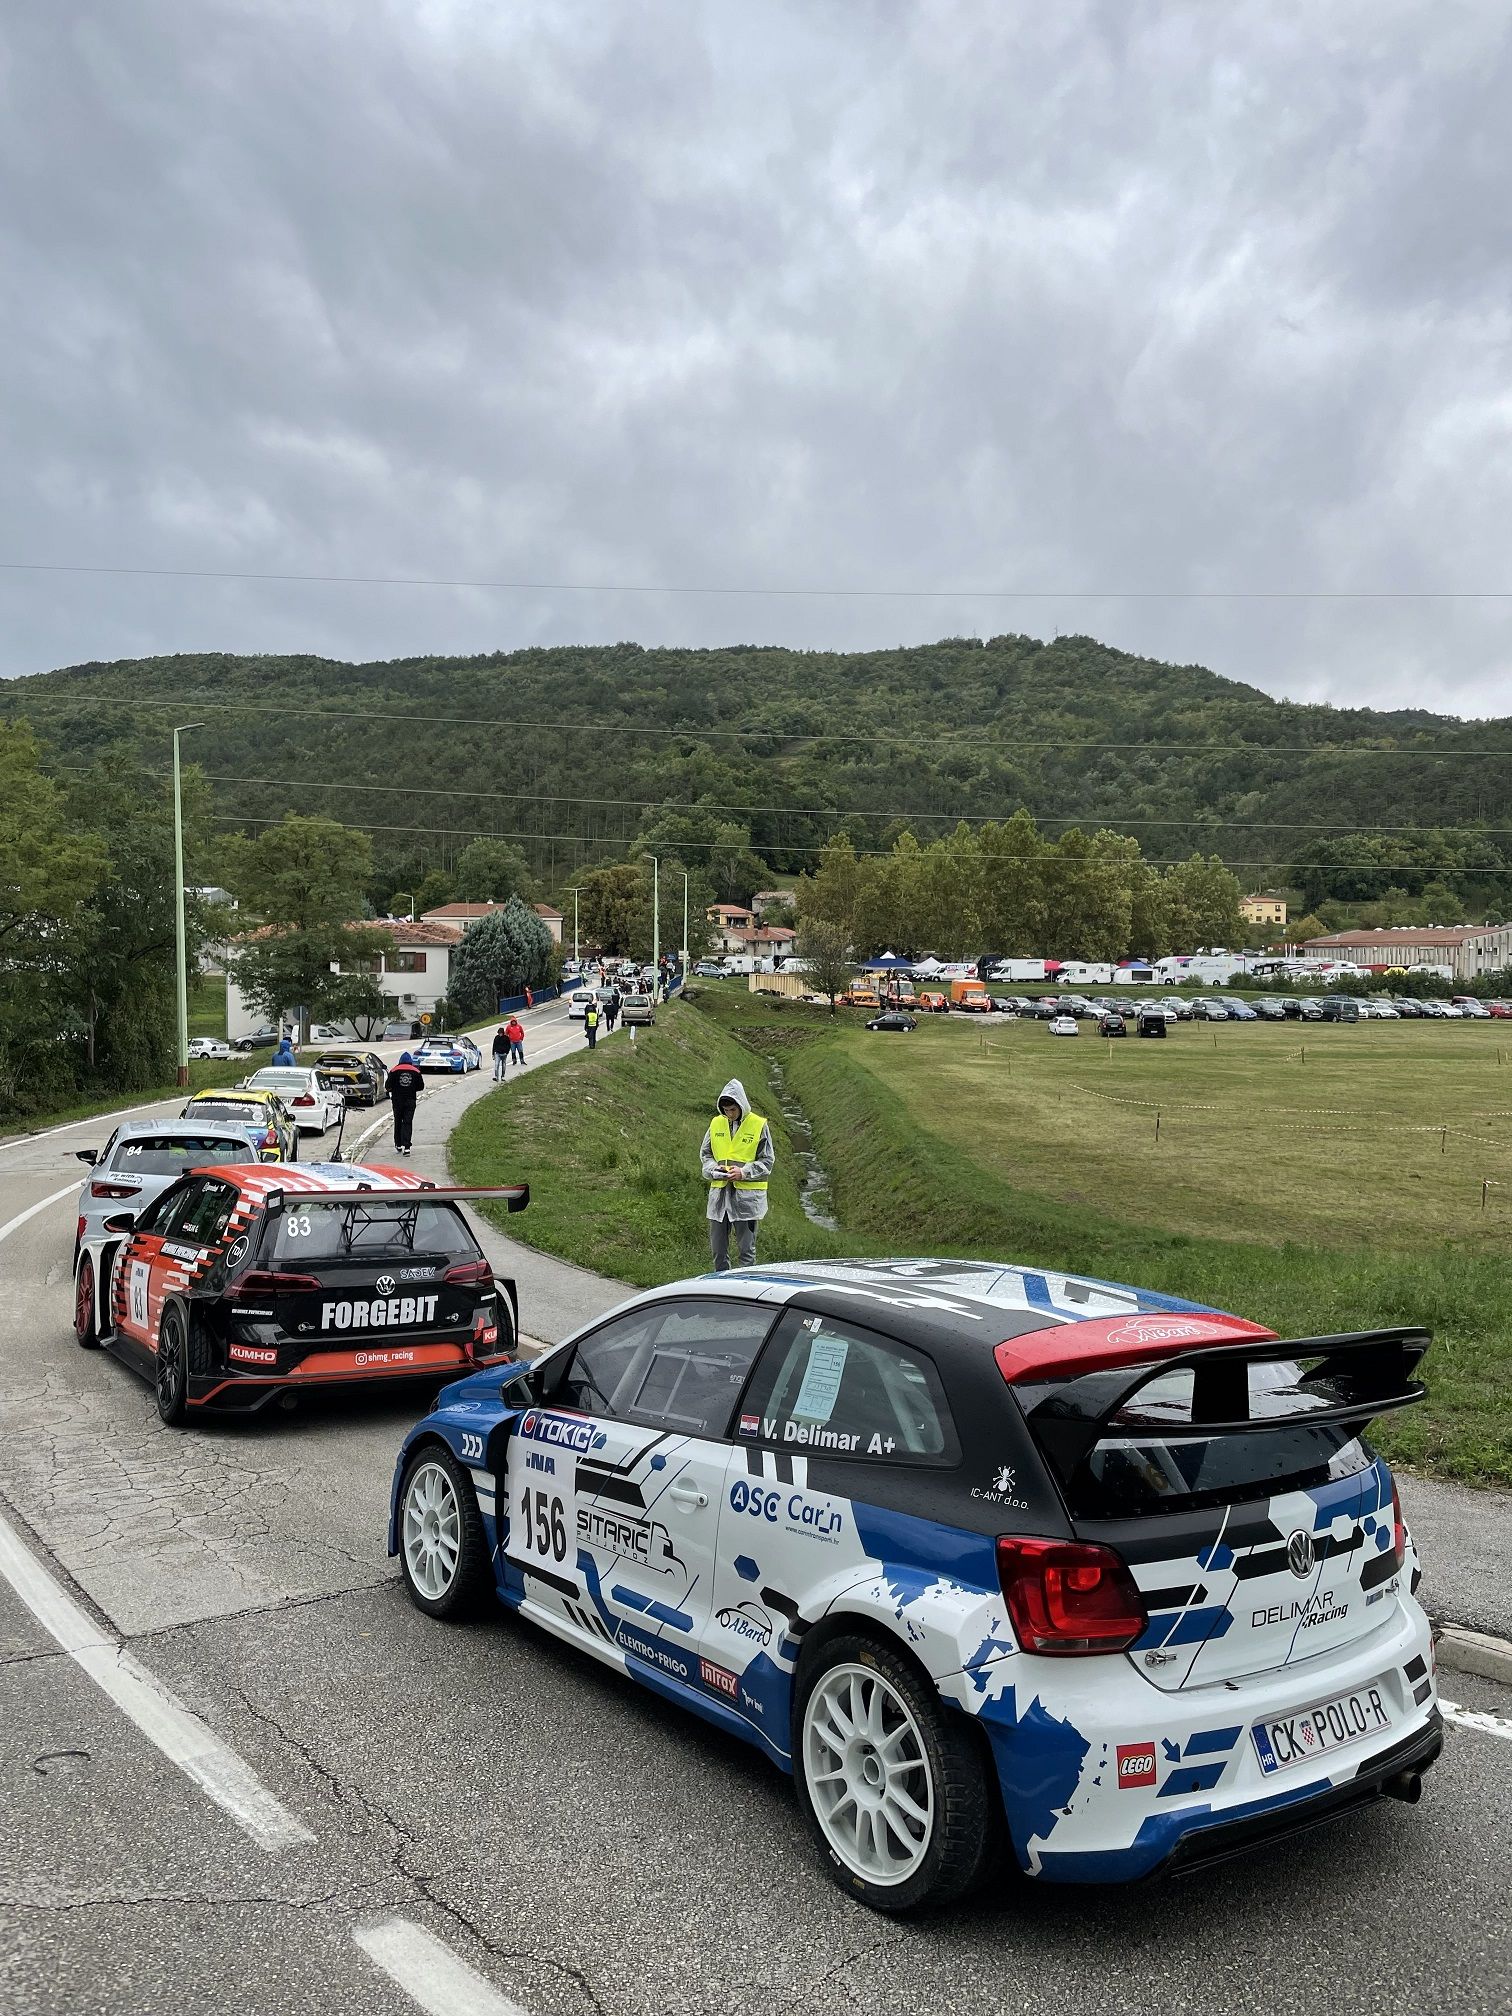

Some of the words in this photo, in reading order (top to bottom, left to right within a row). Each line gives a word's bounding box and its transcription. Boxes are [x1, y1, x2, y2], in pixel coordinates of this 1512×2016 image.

[126, 1145, 142, 1157] 84
[287, 1216, 311, 1237] 83
[400, 1267, 436, 1279] SADEV
[134, 1286, 143, 1320] 83
[321, 1295, 439, 1330] FORGEBIT
[230, 1346, 276, 1361] KUMHO
[368, 1351, 414, 1363] shmg_racing
[539, 1418, 592, 1449] TOKIĆ
[764, 1418, 777, 1440] V.
[784, 1421, 861, 1451] Delimar
[867, 1433, 896, 1455] A+
[730, 1480, 781, 1522] ASC
[970, 1487, 1004, 1502] IC-ANT
[1004, 1496, 1029, 1510] d.o.o.
[521, 1487, 567, 1562] 156
[577, 1509, 649, 1554] SITARIĆ
[577, 1530, 648, 1564] PRIJEVOZ
[1252, 1590, 1334, 1628] DELIMAR
[1307, 1603, 1349, 1628] Racing
[1312, 1689, 1388, 1747] POLO-R
[1120, 1756, 1154, 1776] LEGO
[1262, 1754, 1275, 1767] HR
